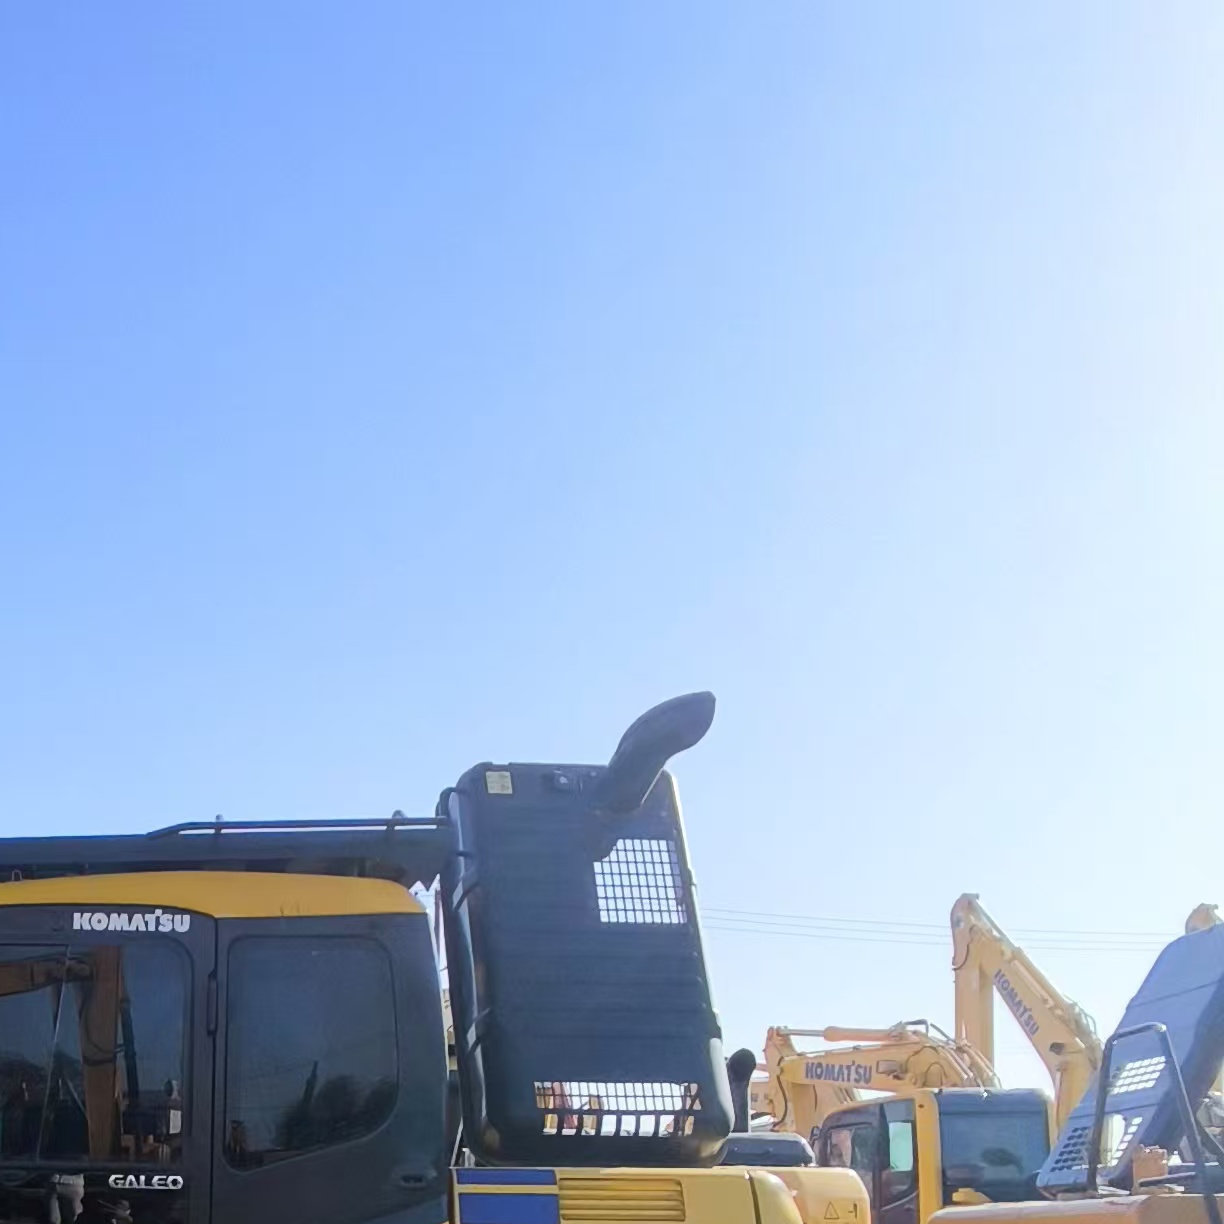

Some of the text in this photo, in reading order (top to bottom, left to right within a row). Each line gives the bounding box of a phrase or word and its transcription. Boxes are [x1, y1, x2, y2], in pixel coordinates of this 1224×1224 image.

[72, 908, 191, 933] KOMATSU
[993, 968, 1040, 1036] KOMATSU
[805, 1060, 873, 1085] KOMATSU
[108, 1174, 184, 1190] GALEO
